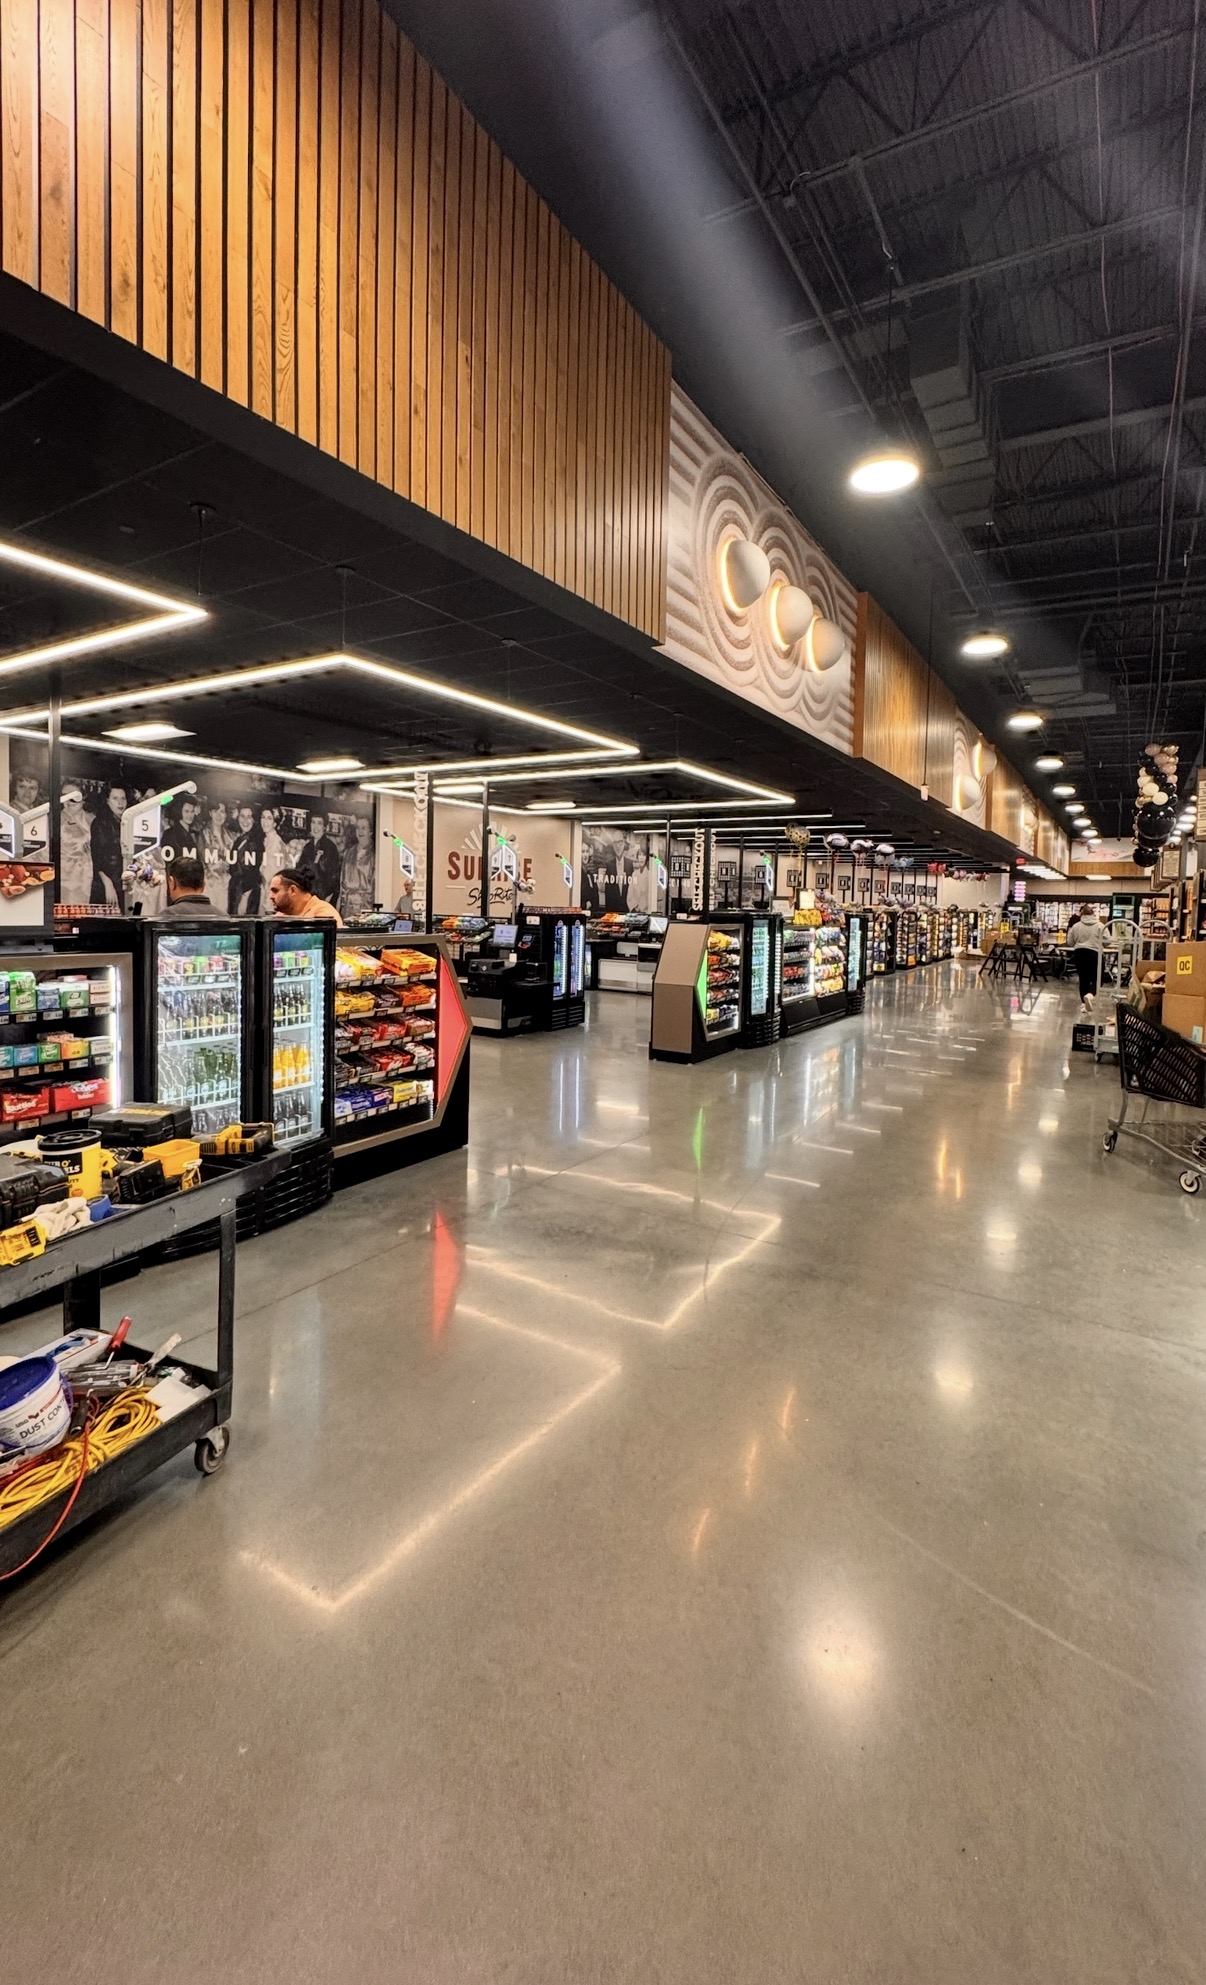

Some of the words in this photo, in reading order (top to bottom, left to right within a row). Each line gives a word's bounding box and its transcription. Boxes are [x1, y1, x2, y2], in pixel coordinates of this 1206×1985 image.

[30, 826, 38, 836] 6
[141, 820, 149, 832] 5
[593, 873, 638, 886] TRADITION
[1179, 960, 1190, 971] QC
[19, 1417, 46, 1439] DUST
